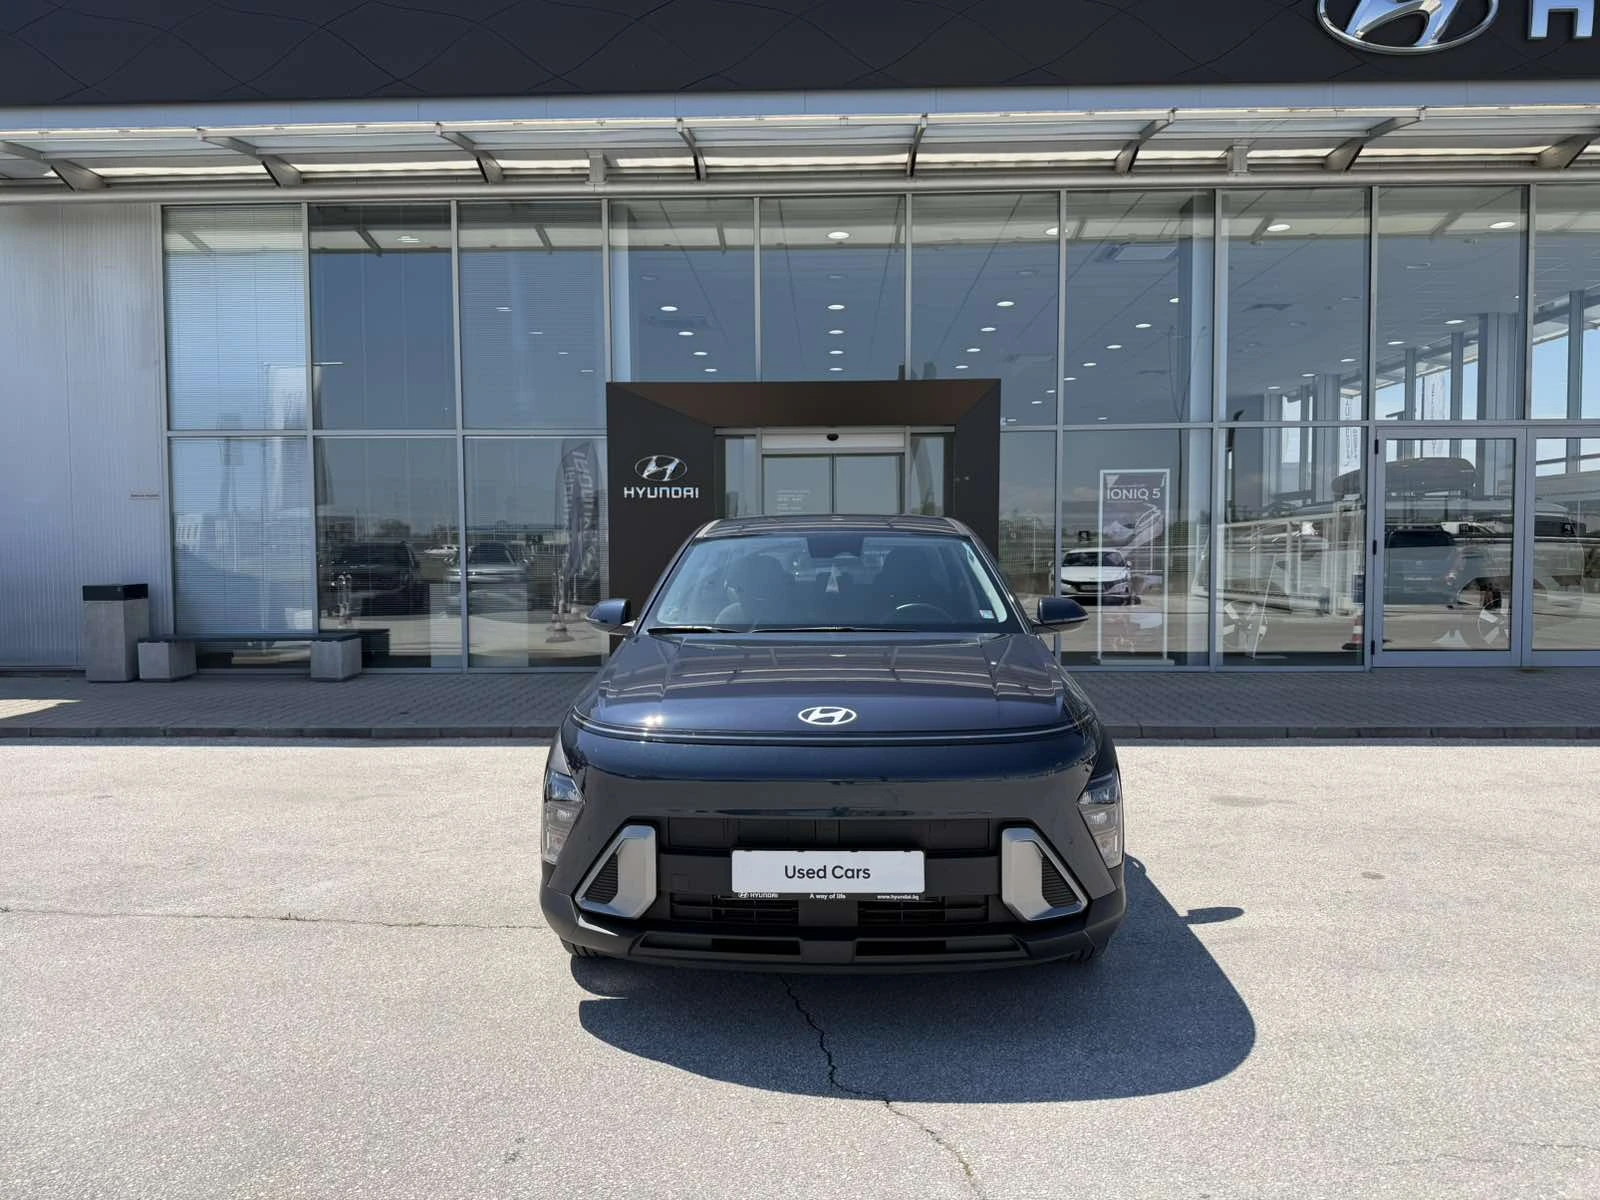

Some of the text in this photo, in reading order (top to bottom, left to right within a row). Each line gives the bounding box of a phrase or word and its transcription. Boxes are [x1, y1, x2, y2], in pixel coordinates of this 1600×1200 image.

[623, 486, 700, 499] HYUNDAI
[1106, 487, 1161, 500] IONIQ 5
[784, 864, 871, 879] Used Cars
